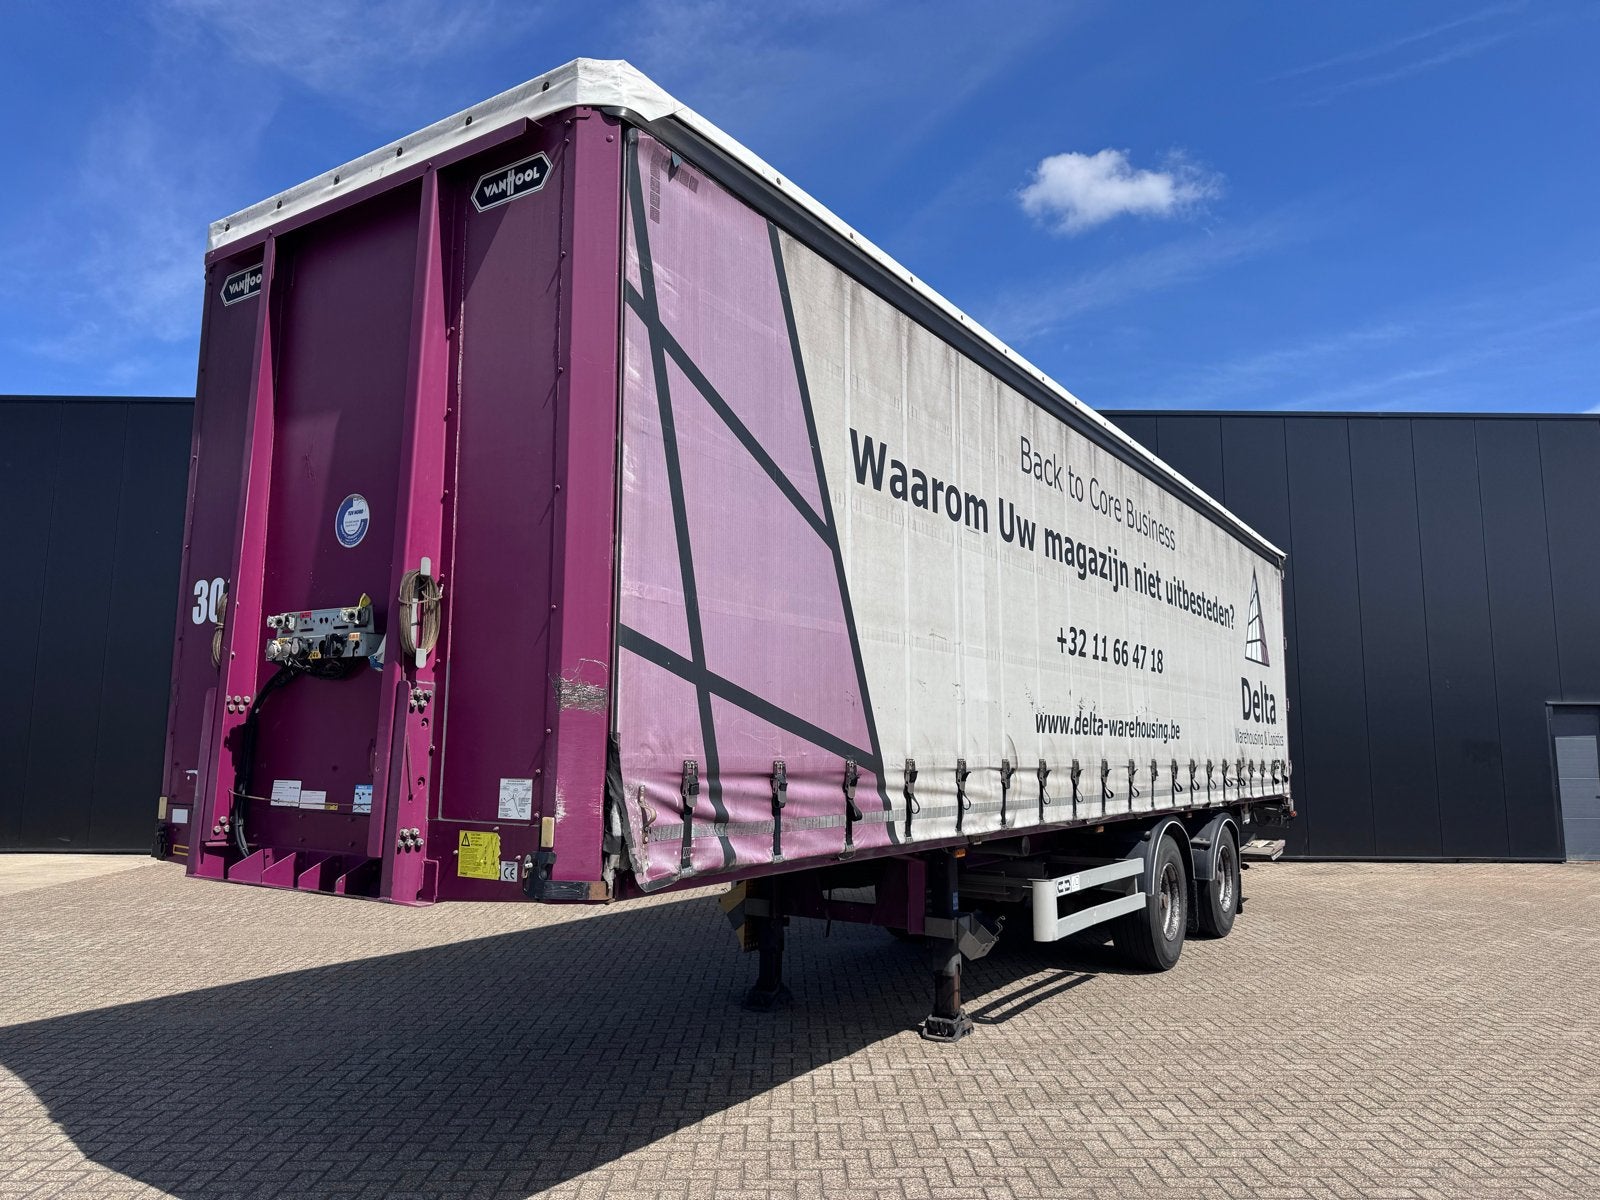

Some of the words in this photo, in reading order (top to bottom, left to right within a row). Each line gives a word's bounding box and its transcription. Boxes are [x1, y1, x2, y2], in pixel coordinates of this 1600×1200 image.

[1020, 435, 1063, 492] Back
[1068, 465, 1084, 503] to
[1089, 477, 1122, 523] Core
[1126, 498, 1176, 551] Business
[849, 427, 988, 534] Waarom
[998, 497, 1036, 552] Uw
[1044, 527, 1129, 592] magazijn
[1134, 562, 1162, 601] niet
[1165, 576, 1235, 630] uitbesteden?
[1056, 626, 1087, 658] +32
[1092, 633, 1108, 662] 11
[1113, 638, 1129, 667] 66
[1132, 643, 1147, 670] 47
[1150, 648, 1164, 674] 18
[1241, 676, 1277, 726] Delta
[1035, 710, 1181, 744] www.delta-warehousing.be
[1234, 727, 1263, 750] Warehousing
